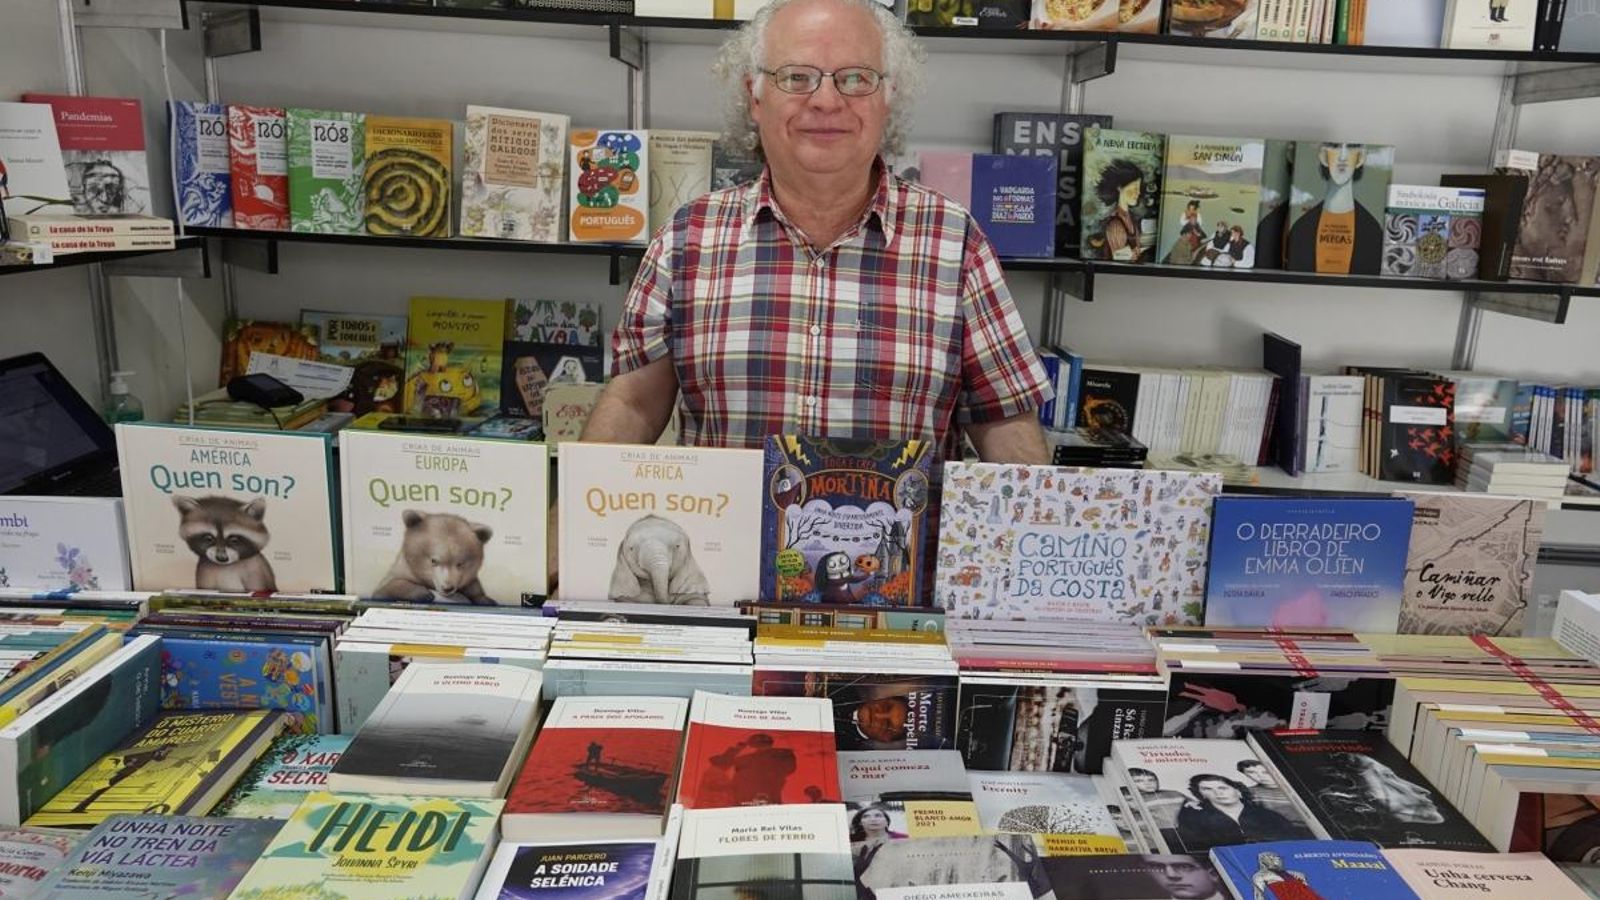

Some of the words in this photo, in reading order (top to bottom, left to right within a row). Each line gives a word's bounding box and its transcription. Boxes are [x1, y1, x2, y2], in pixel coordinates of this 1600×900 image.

[61, 111, 113, 122] Pandemias
[490, 144, 537, 156] GALEGOS
[1103, 138, 1124, 149] NENA
[1194, 151, 1213, 161] SAN
[1438, 196, 1479, 210] Galicia
[190, 447, 251, 467] AMÉRICA
[416, 455, 469, 473] EUROPA
[635, 462, 684, 481] ÁFRICA
[150, 464, 222, 494] Quen
[232, 472, 296, 499] son?
[808, 471, 892, 500] MORTINA
[368, 478, 439, 507] Quen
[450, 485, 513, 512] son?
[586, 487, 656, 517] Quen
[666, 493, 730, 518] son?
[1236, 522, 1255, 541] O
[1260, 522, 1381, 541] DERRADEIRO
[1264, 540, 1321, 557] LIBRO
[1326, 540, 1350, 557] DE
[1245, 557, 1300, 575] EMMA
[1306, 557, 1365, 575] OLSEN
[1419, 562, 1501, 586] Camiñar
[1416, 590, 1422, 598] o
[1428, 584, 1457, 604] Vigo
[1461, 586, 1496, 602] vello
[907, 691, 918, 711] no
[919, 692, 932, 733] Morte
[1125, 708, 1136, 721] Só
[850, 764, 882, 774] Aquí
[981, 784, 1029, 795] Eternity
[110, 820, 168, 835] UNHA
[172, 822, 235, 837] NOITE
[308, 801, 473, 854] HEIDI
[93, 836, 127, 848] NO
[130, 836, 186, 851] TREN
[188, 839, 218, 853] DA
[718, 834, 759, 844] FLORES
[763, 834, 779, 843] DE
[783, 832, 816, 841] FERRO
[539, 854, 565, 863] JUAN
[567, 852, 607, 861] PARCERO
[535, 865, 546, 875] A
[550, 861, 619, 874] SOIDADE
[1424, 869, 1472, 880] Unha
[1473, 873, 1534, 881] cervexa
[530, 873, 605, 889] SELÉNICA
[1432, 879, 1492, 893] Chang
[939, 890, 1005, 900] AMEIXEIRAS
